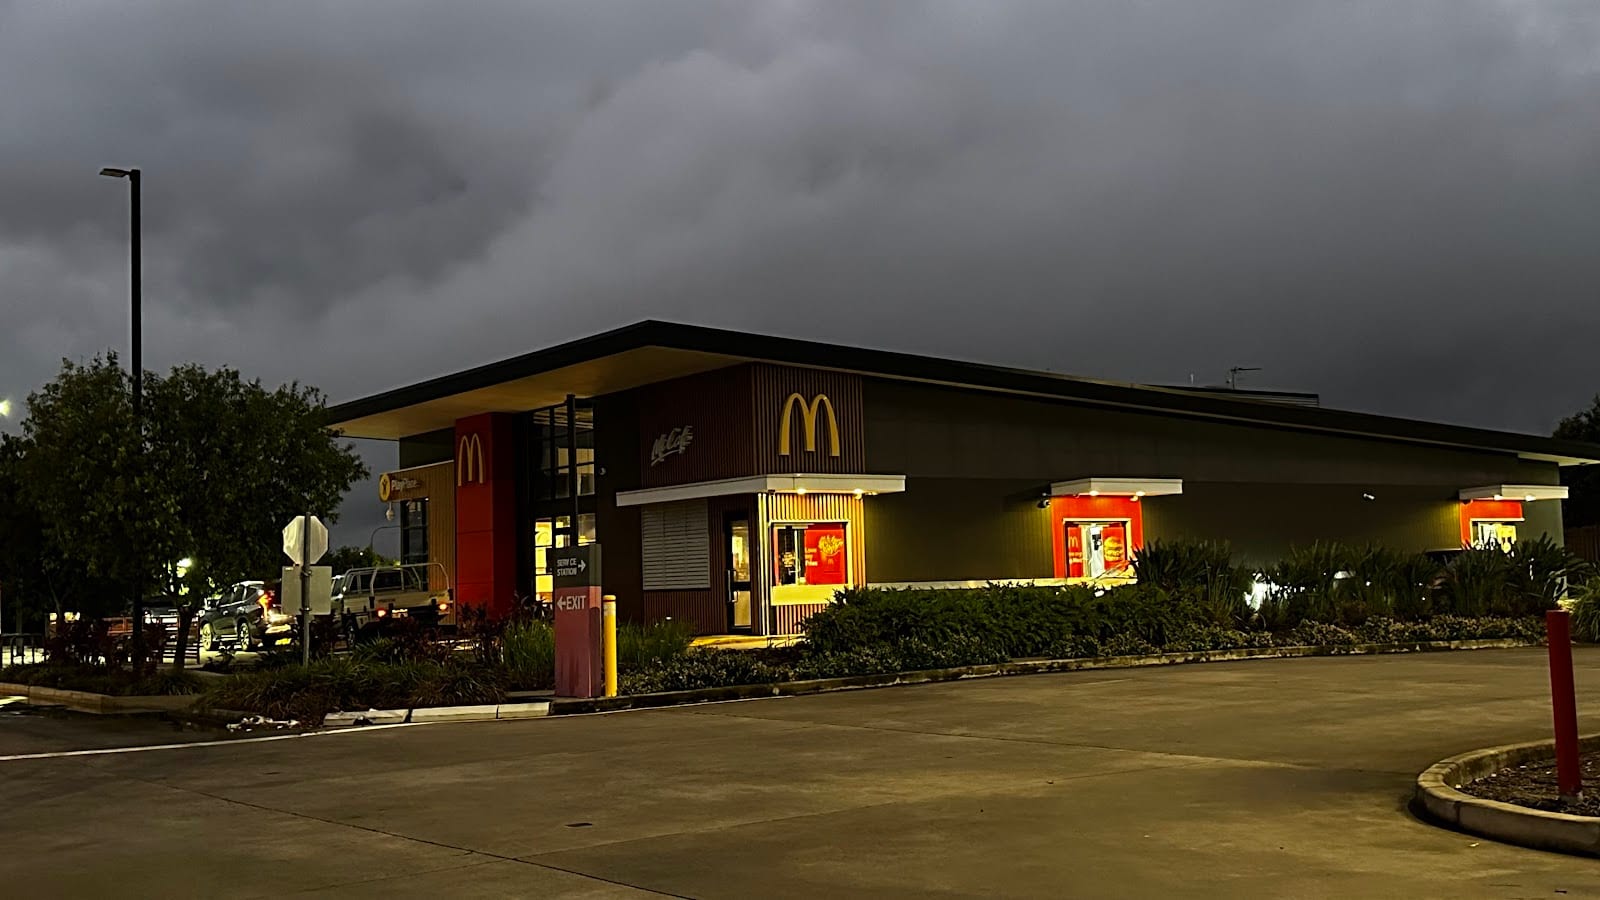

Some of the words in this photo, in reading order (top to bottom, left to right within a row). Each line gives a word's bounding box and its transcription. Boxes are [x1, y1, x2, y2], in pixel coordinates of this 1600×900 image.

[780, 392, 840, 457] M
[457, 432, 484, 486] M
[391, 477, 424, 491] PlayPlac
[556, 557, 577, 567] SERVCE
[556, 567, 578, 577] STATION
[566, 595, 587, 610] EXIT
